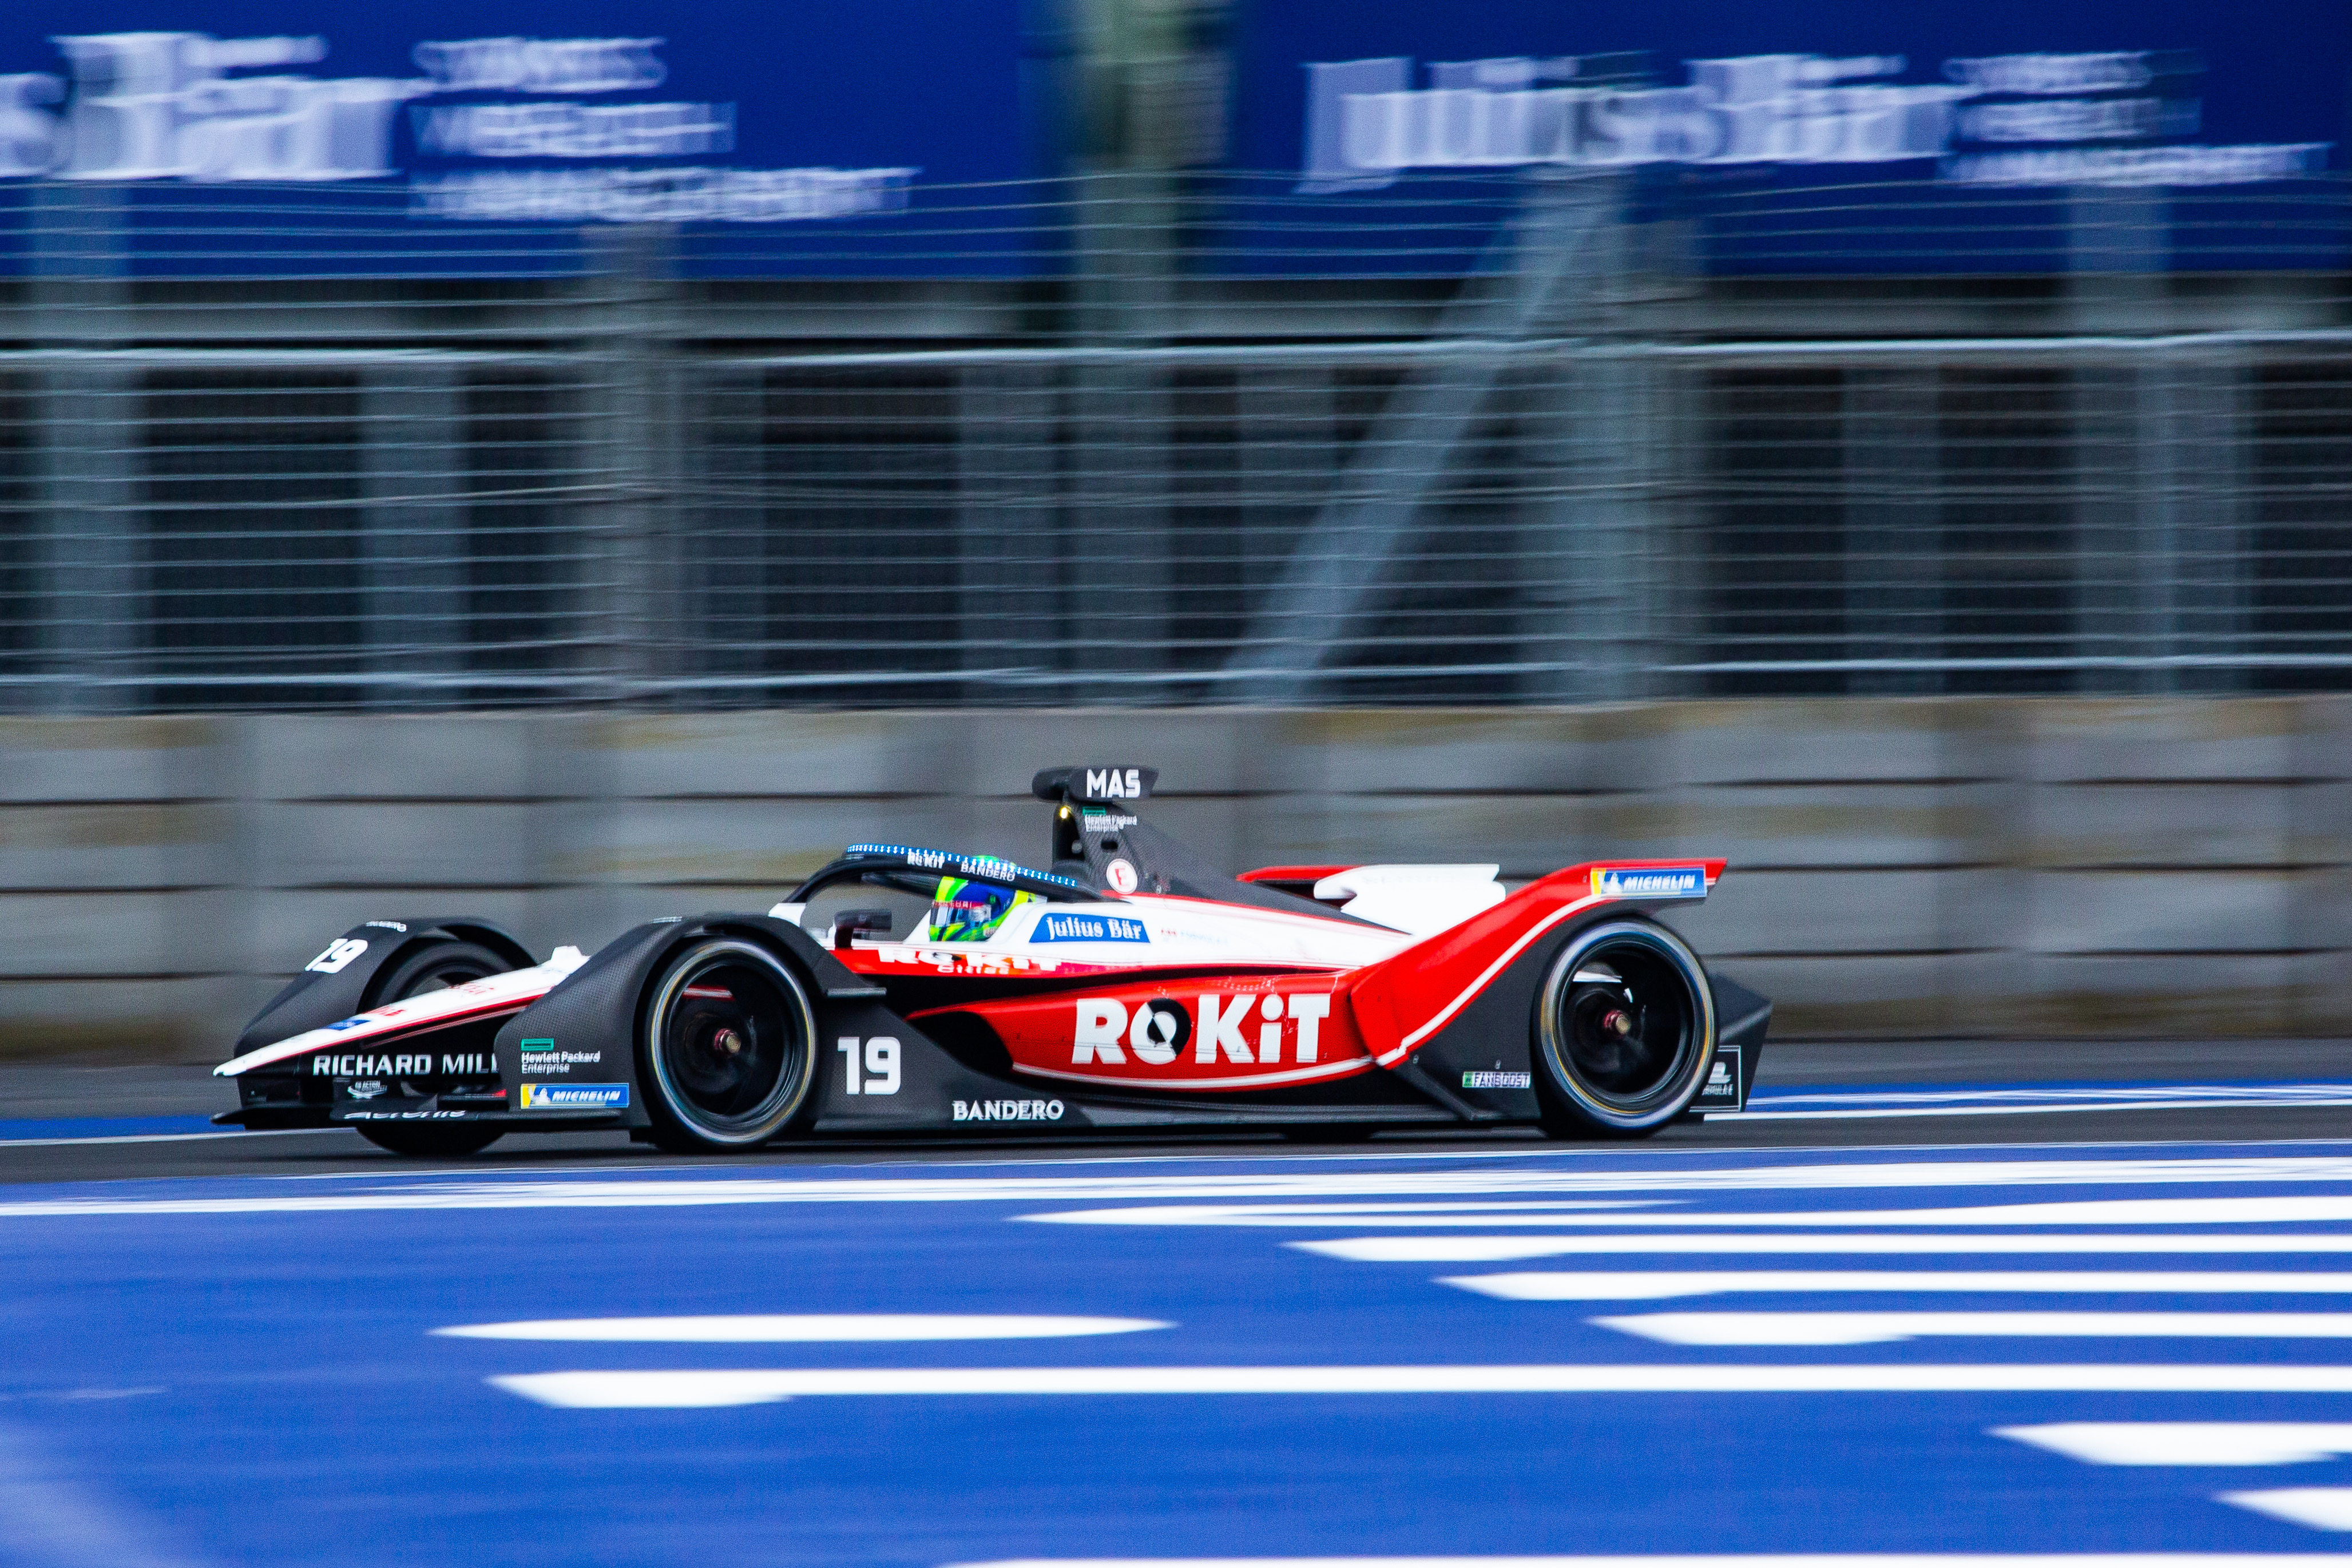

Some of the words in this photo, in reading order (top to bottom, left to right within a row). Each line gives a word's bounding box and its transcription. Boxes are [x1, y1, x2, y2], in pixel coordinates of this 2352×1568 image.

[1086, 769, 1141, 798] MAS
[960, 861, 1016, 882] BANDERO
[1623, 875, 1696, 890] MICHELIN
[1046, 916, 1104, 940] Julius
[1106, 918, 1143, 940] Bär
[304, 938, 368, 974] 19
[313, 1054, 432, 1075] RICHARD
[521, 1051, 560, 1063] Hewlett
[561, 1050, 601, 1063] Packard
[837, 1037, 901, 1095] 19
[521, 1062, 570, 1075] Enterprise
[552, 1090, 621, 1101] MICHELIN
[952, 1099, 1065, 1121] BANDERO
